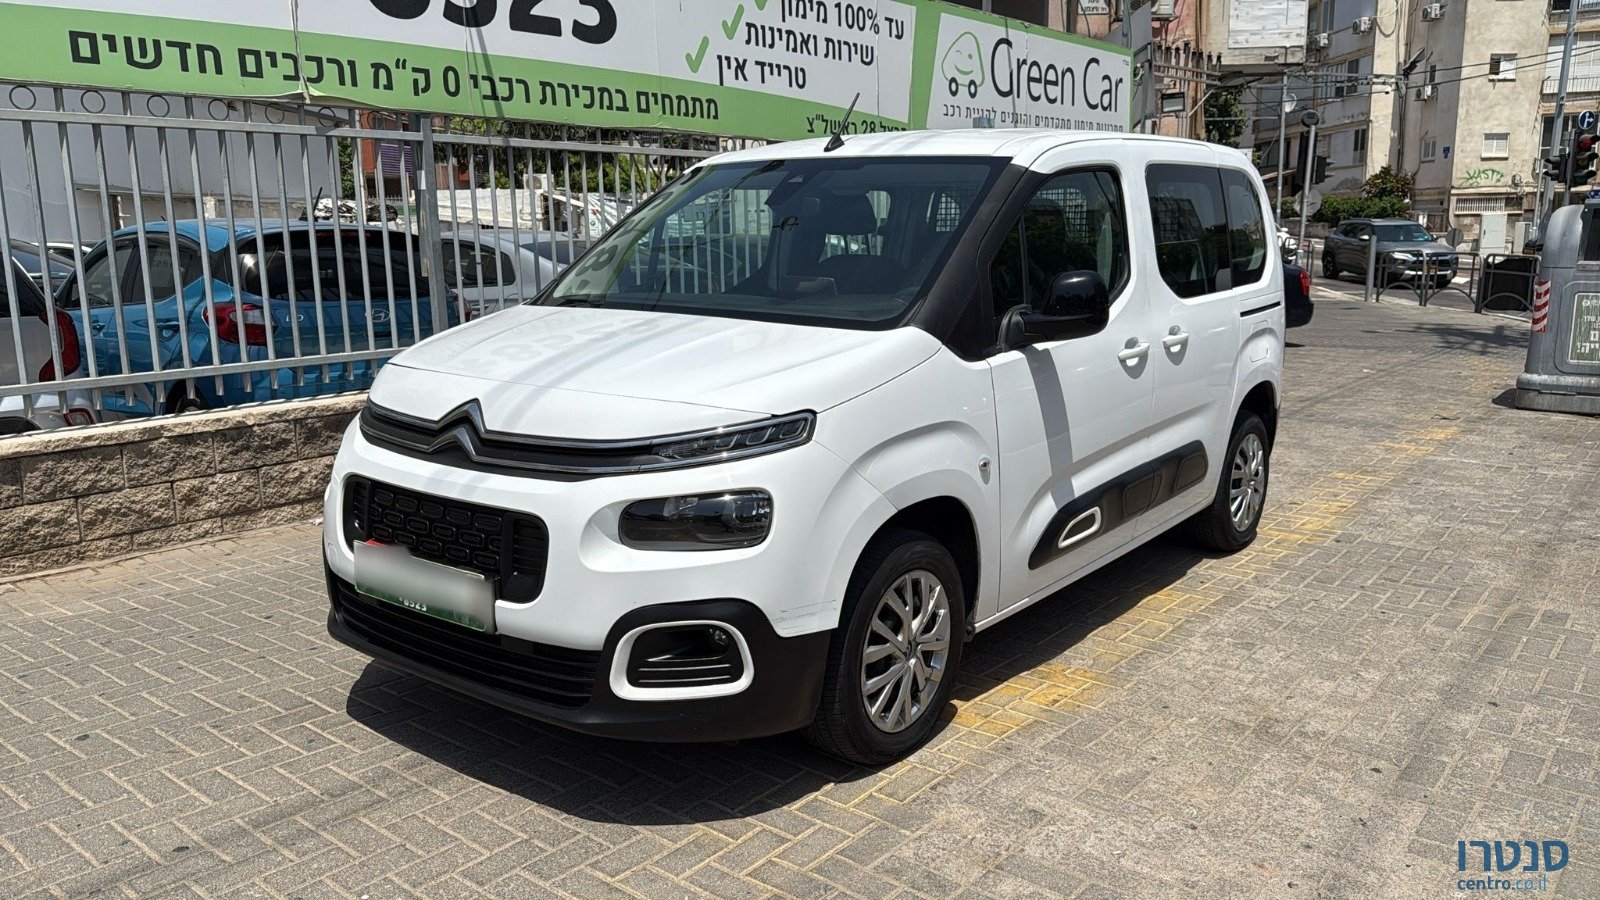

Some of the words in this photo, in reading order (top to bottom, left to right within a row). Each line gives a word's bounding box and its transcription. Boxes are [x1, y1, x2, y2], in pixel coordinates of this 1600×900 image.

[780, 0, 828, 24] מימון
[835, 2, 880, 35] 100%
[885, 16, 904, 40] עד
[68, 30, 223, 76] חדשים
[745, 21, 818, 57] ואמינות
[824, 36, 875, 66] שירות
[237, 47, 358, 88] ורכבים
[442, 65, 461, 97] 0
[716, 54, 748, 87] אין
[755, 60, 807, 89] טרייד
[990, 37, 1076, 107] Green
[1083, 57, 1123, 113] Car
[469, 73, 531, 104] רכבי
[539, 79, 630, 113] במכירת
[636, 90, 719, 120] מתמחים
[943, 104, 962, 118] רכב
